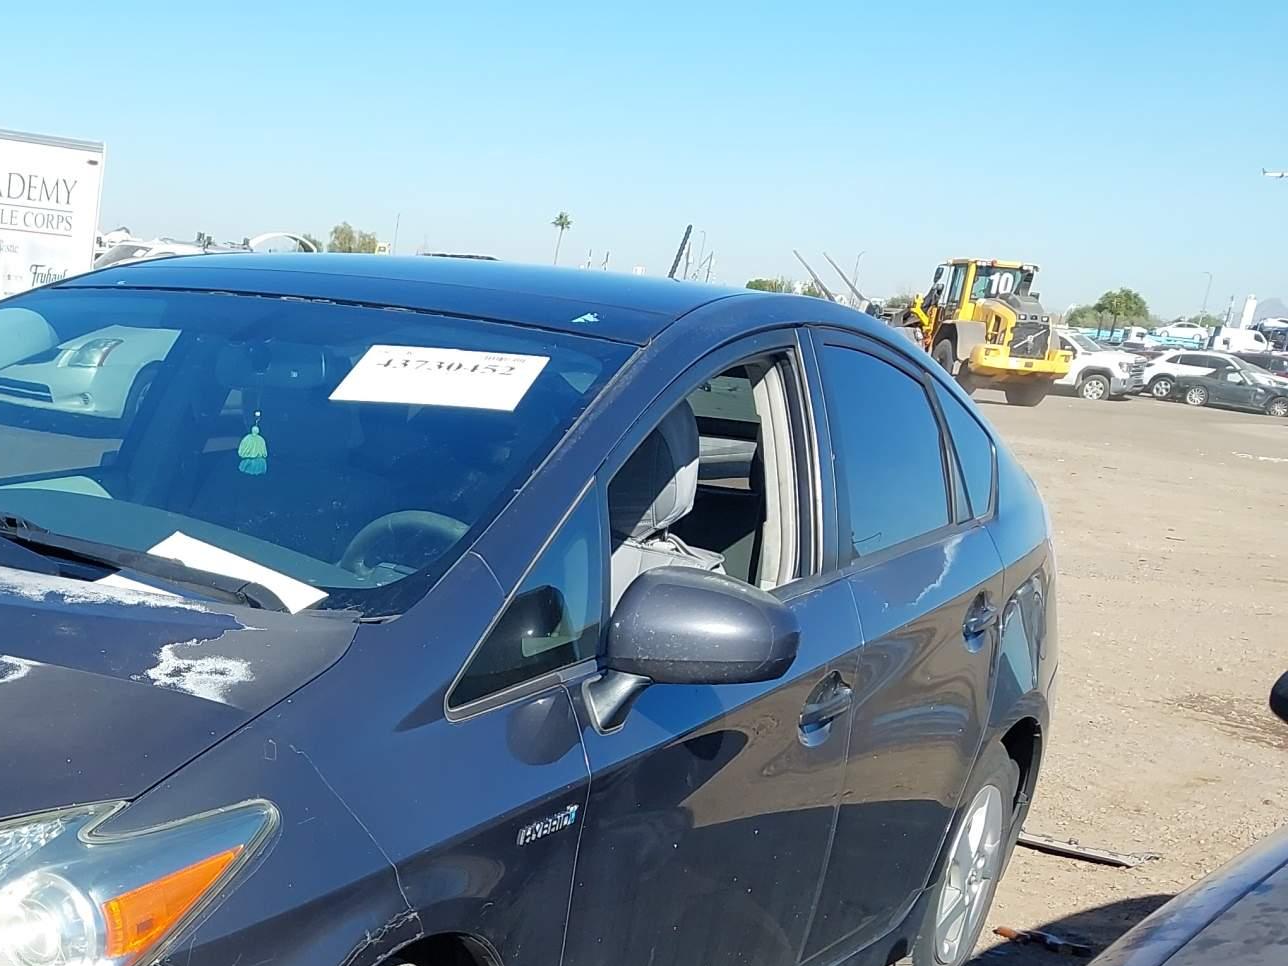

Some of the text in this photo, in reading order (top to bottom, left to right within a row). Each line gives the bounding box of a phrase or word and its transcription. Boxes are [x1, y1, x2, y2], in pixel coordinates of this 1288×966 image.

[23, 210, 73, 232] CORPS
[989, 271, 1014, 295] 10
[376, 358, 516, 376] 43730452
